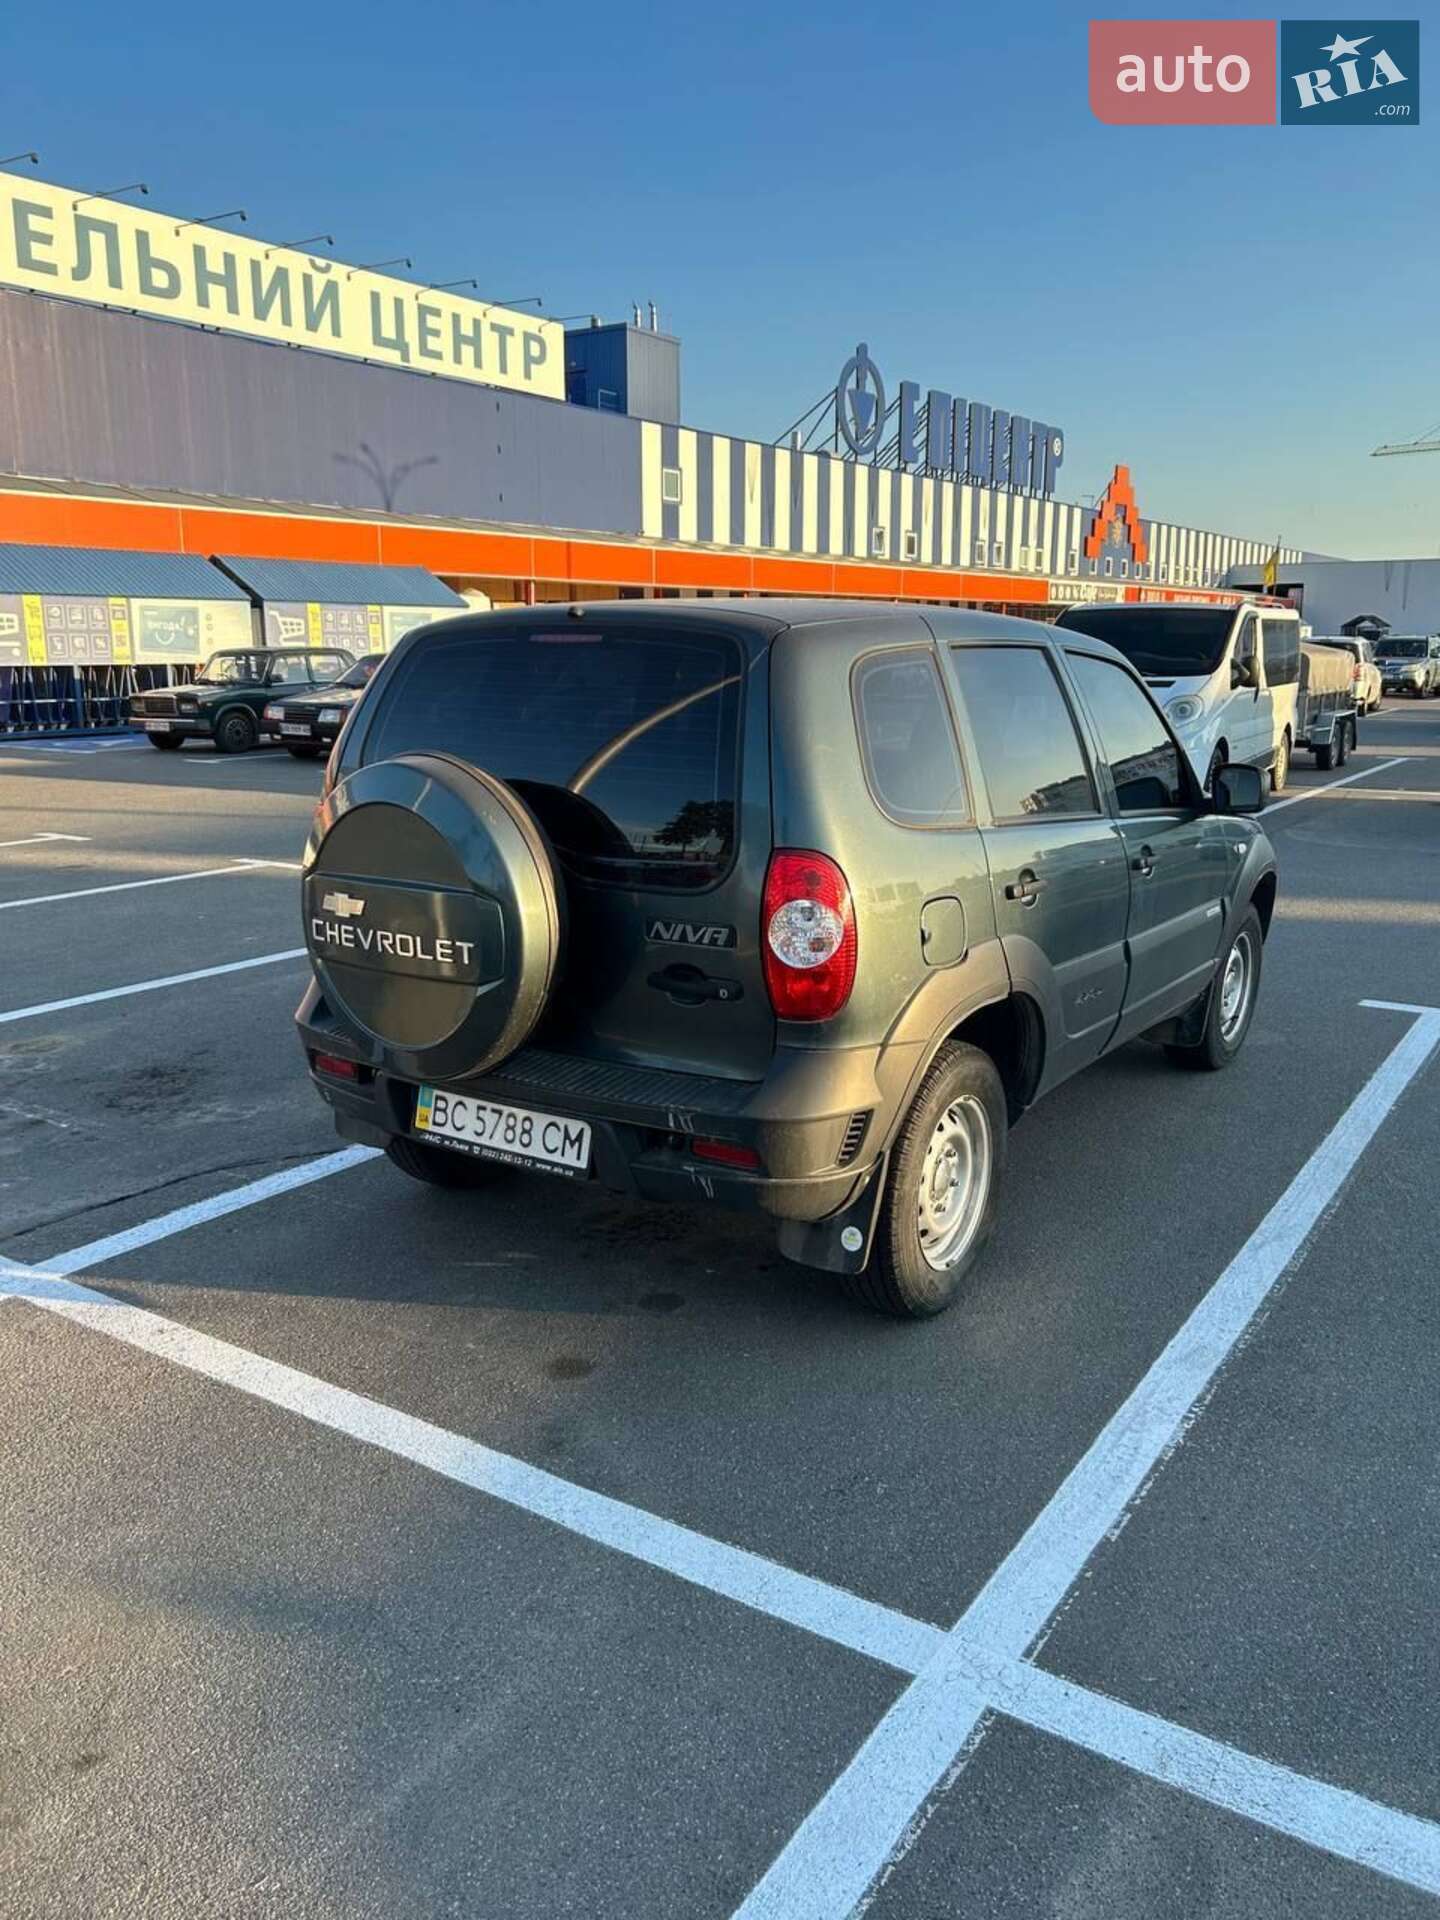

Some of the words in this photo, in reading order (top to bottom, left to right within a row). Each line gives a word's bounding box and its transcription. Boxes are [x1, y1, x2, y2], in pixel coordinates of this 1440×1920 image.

[11, 197, 342, 339] ЕЛЬНИЙ
[369, 290, 548, 381] ЦЕНТР
[312, 918, 475, 965] CHEVROLET
[650, 921, 729, 945] NIVA
[432, 1094, 468, 1132] BC
[473, 1105, 534, 1149] 5788
[542, 1121, 585, 1161] CM
